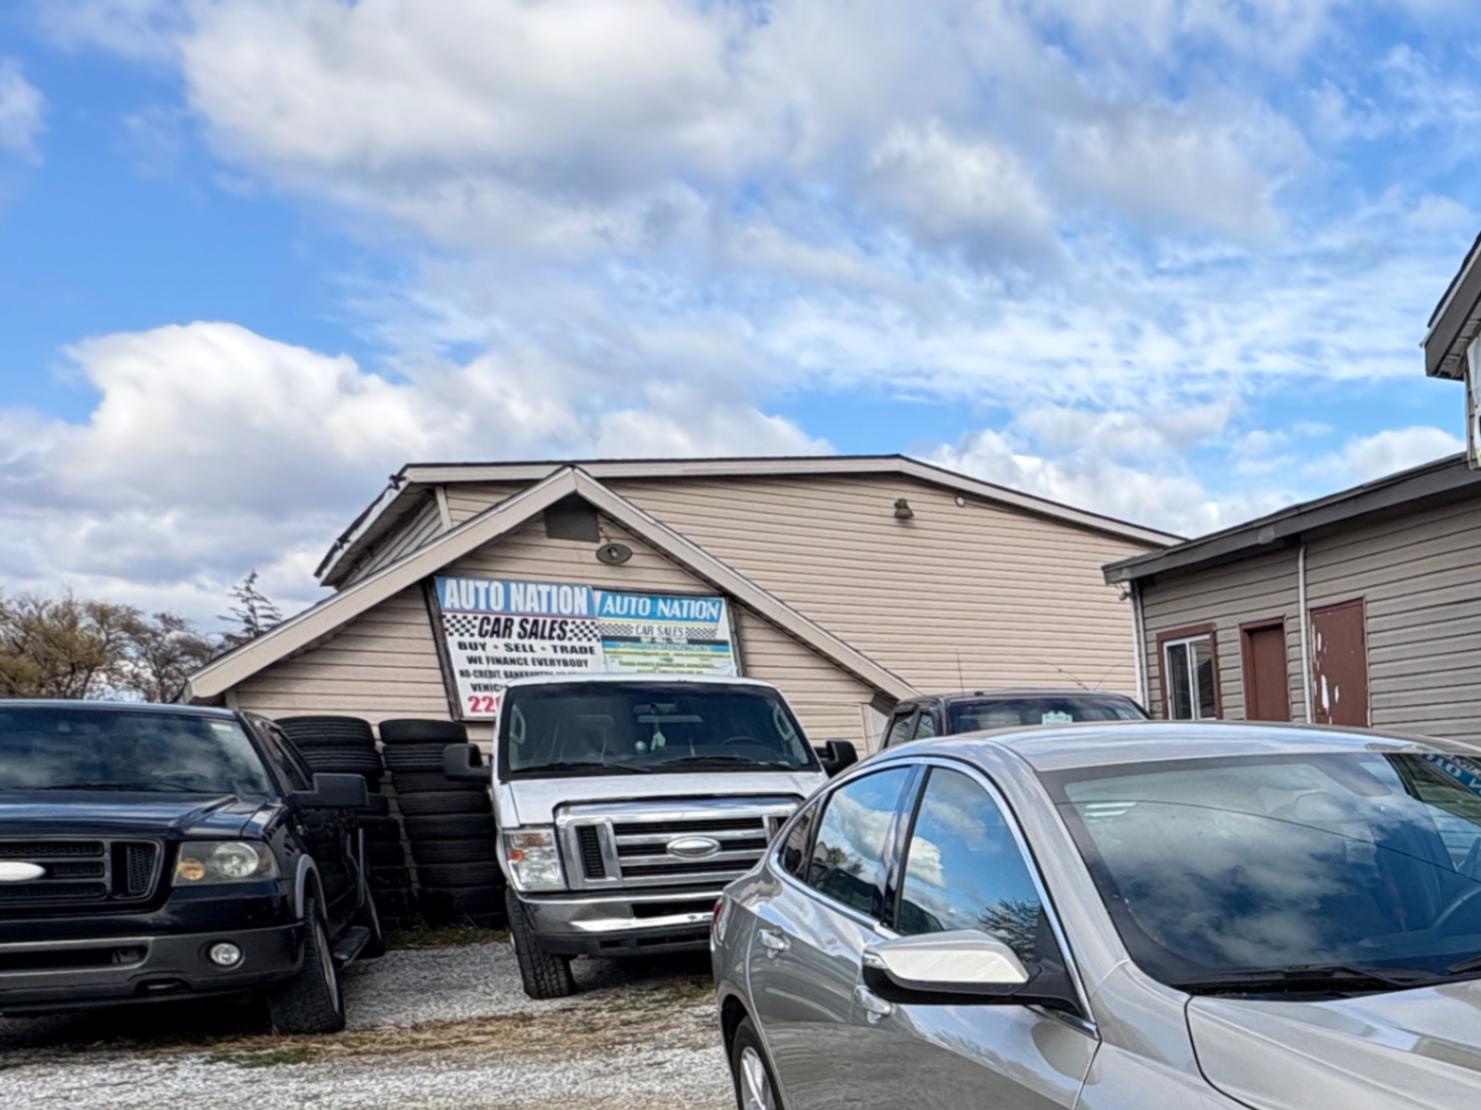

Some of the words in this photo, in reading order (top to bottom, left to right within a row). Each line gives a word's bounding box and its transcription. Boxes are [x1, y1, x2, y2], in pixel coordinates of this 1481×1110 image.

[444, 579, 505, 612] AUTO
[510, 582, 588, 615] NATION
[602, 595, 651, 616] AUTO
[657, 598, 720, 620] NATION
[478, 616, 514, 639] CAR
[517, 617, 569, 641] SALES
[635, 624, 654, 636] CAR
[658, 625, 686, 637] SALES
[457, 642, 487, 651] BUY
[504, 643, 536, 653] SELL
[551, 644, 597, 655] TRADE
[466, 655, 483, 665] WE
[486, 656, 530, 666] FINANCE
[531, 657, 589, 668] EVERYBODY
